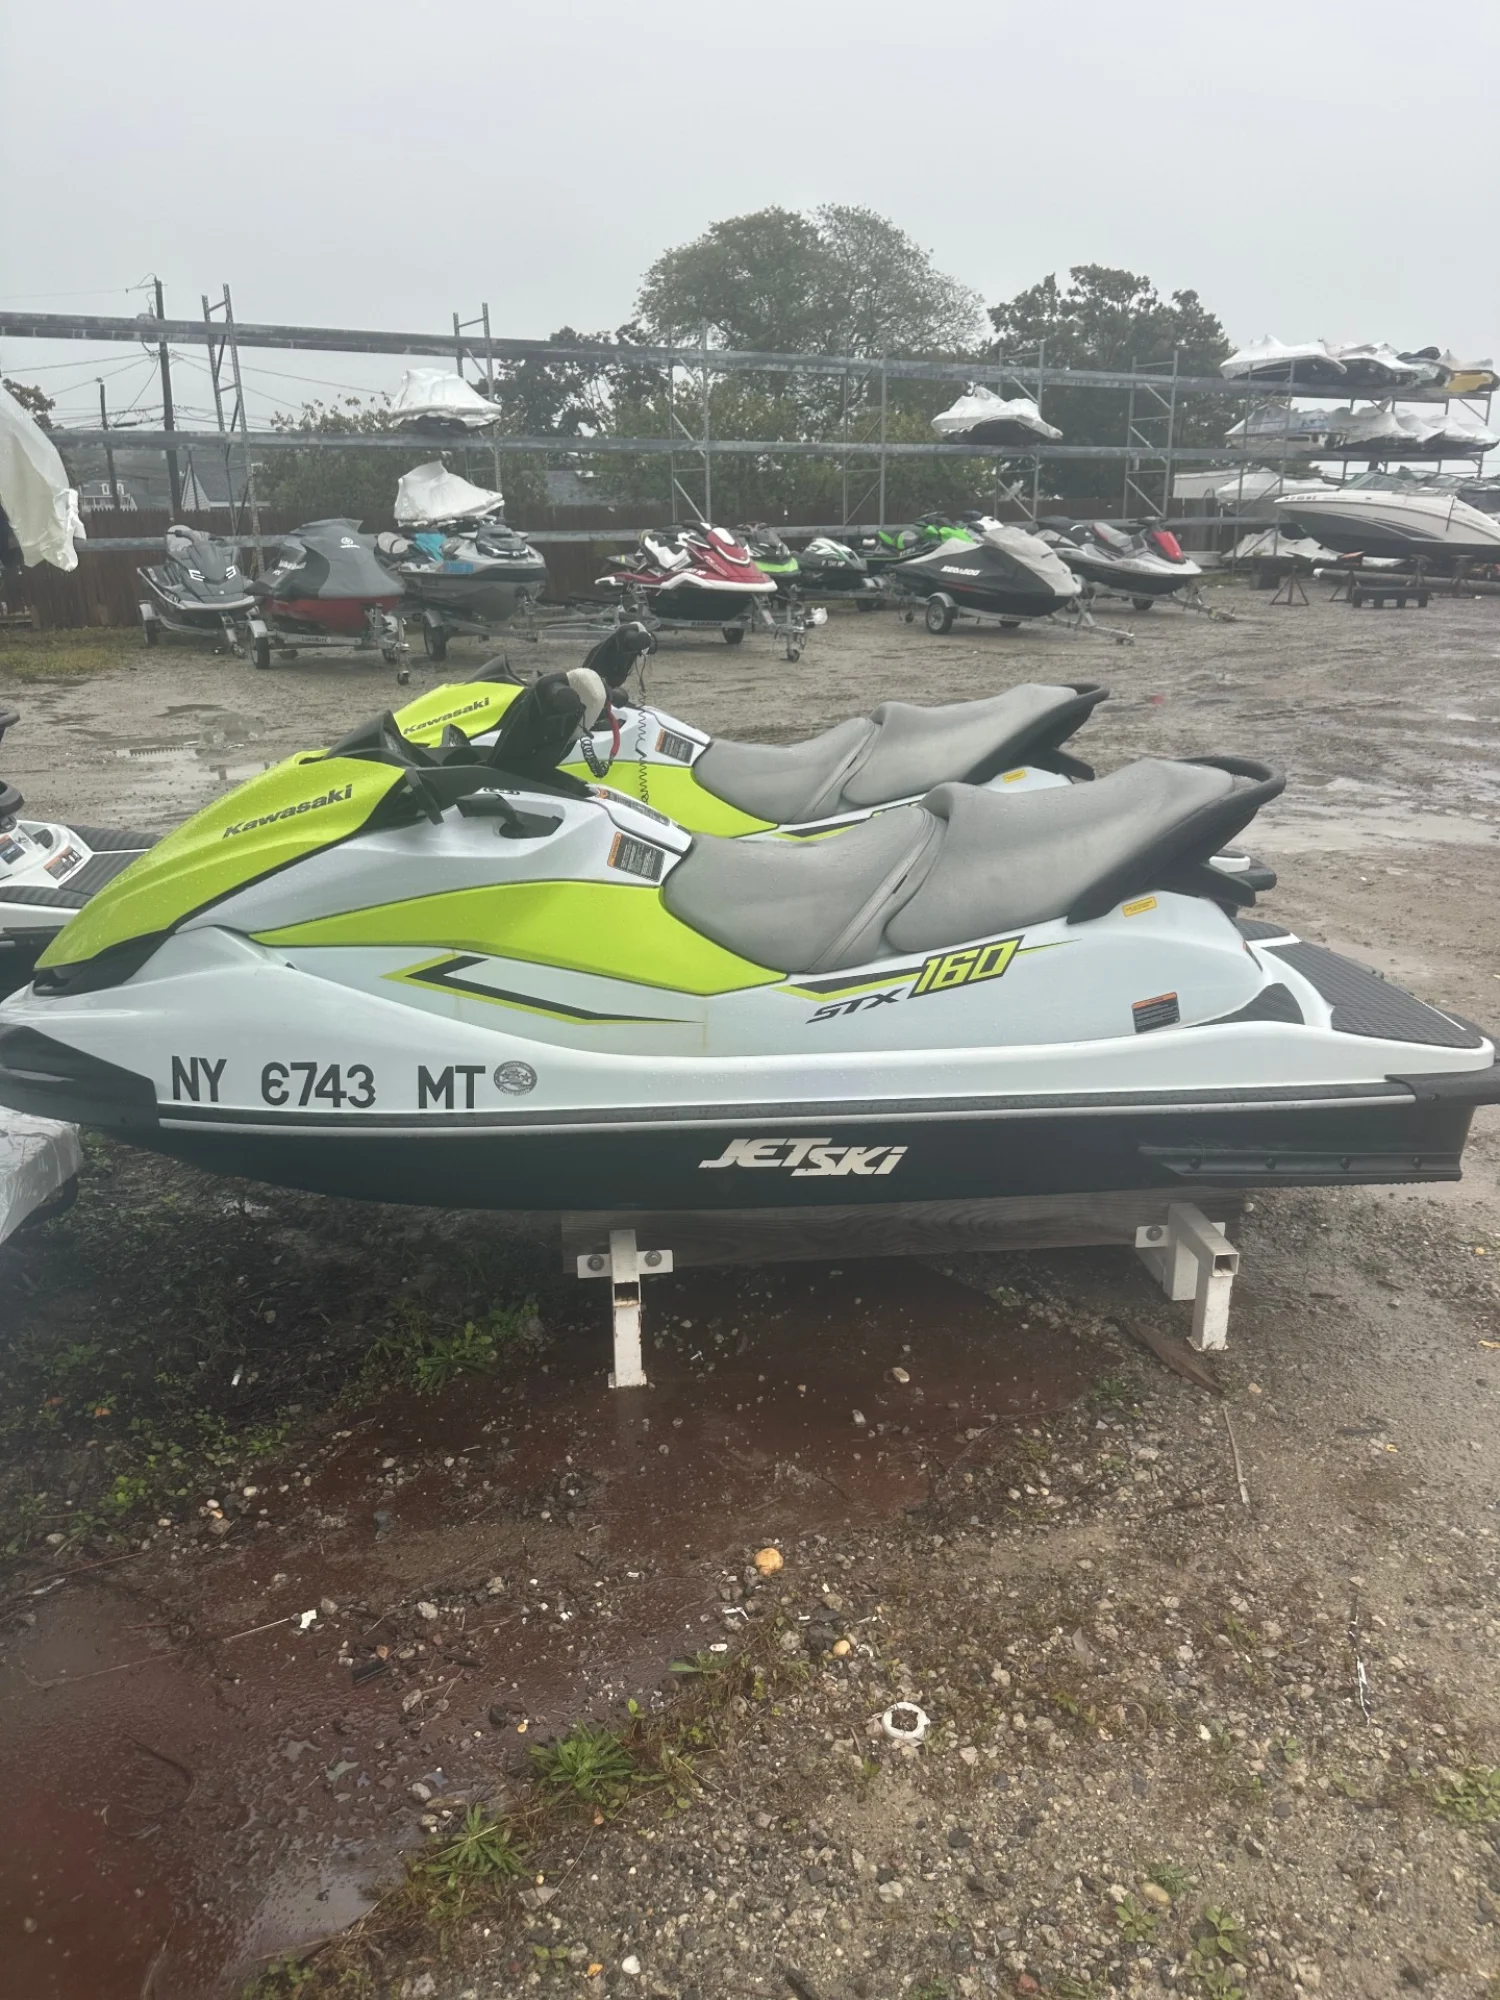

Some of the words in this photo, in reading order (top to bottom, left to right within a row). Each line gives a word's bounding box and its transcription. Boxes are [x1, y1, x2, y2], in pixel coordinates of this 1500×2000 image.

[403, 697, 489, 735] Kawasaki
[222, 783, 352, 839] Kawasaki
[805, 987, 907, 1024] STX
[914, 939, 1020, 994] 160
[171, 1055, 227, 1103] NY
[261, 1061, 377, 1109] 6743
[418, 1065, 486, 1109] MT
